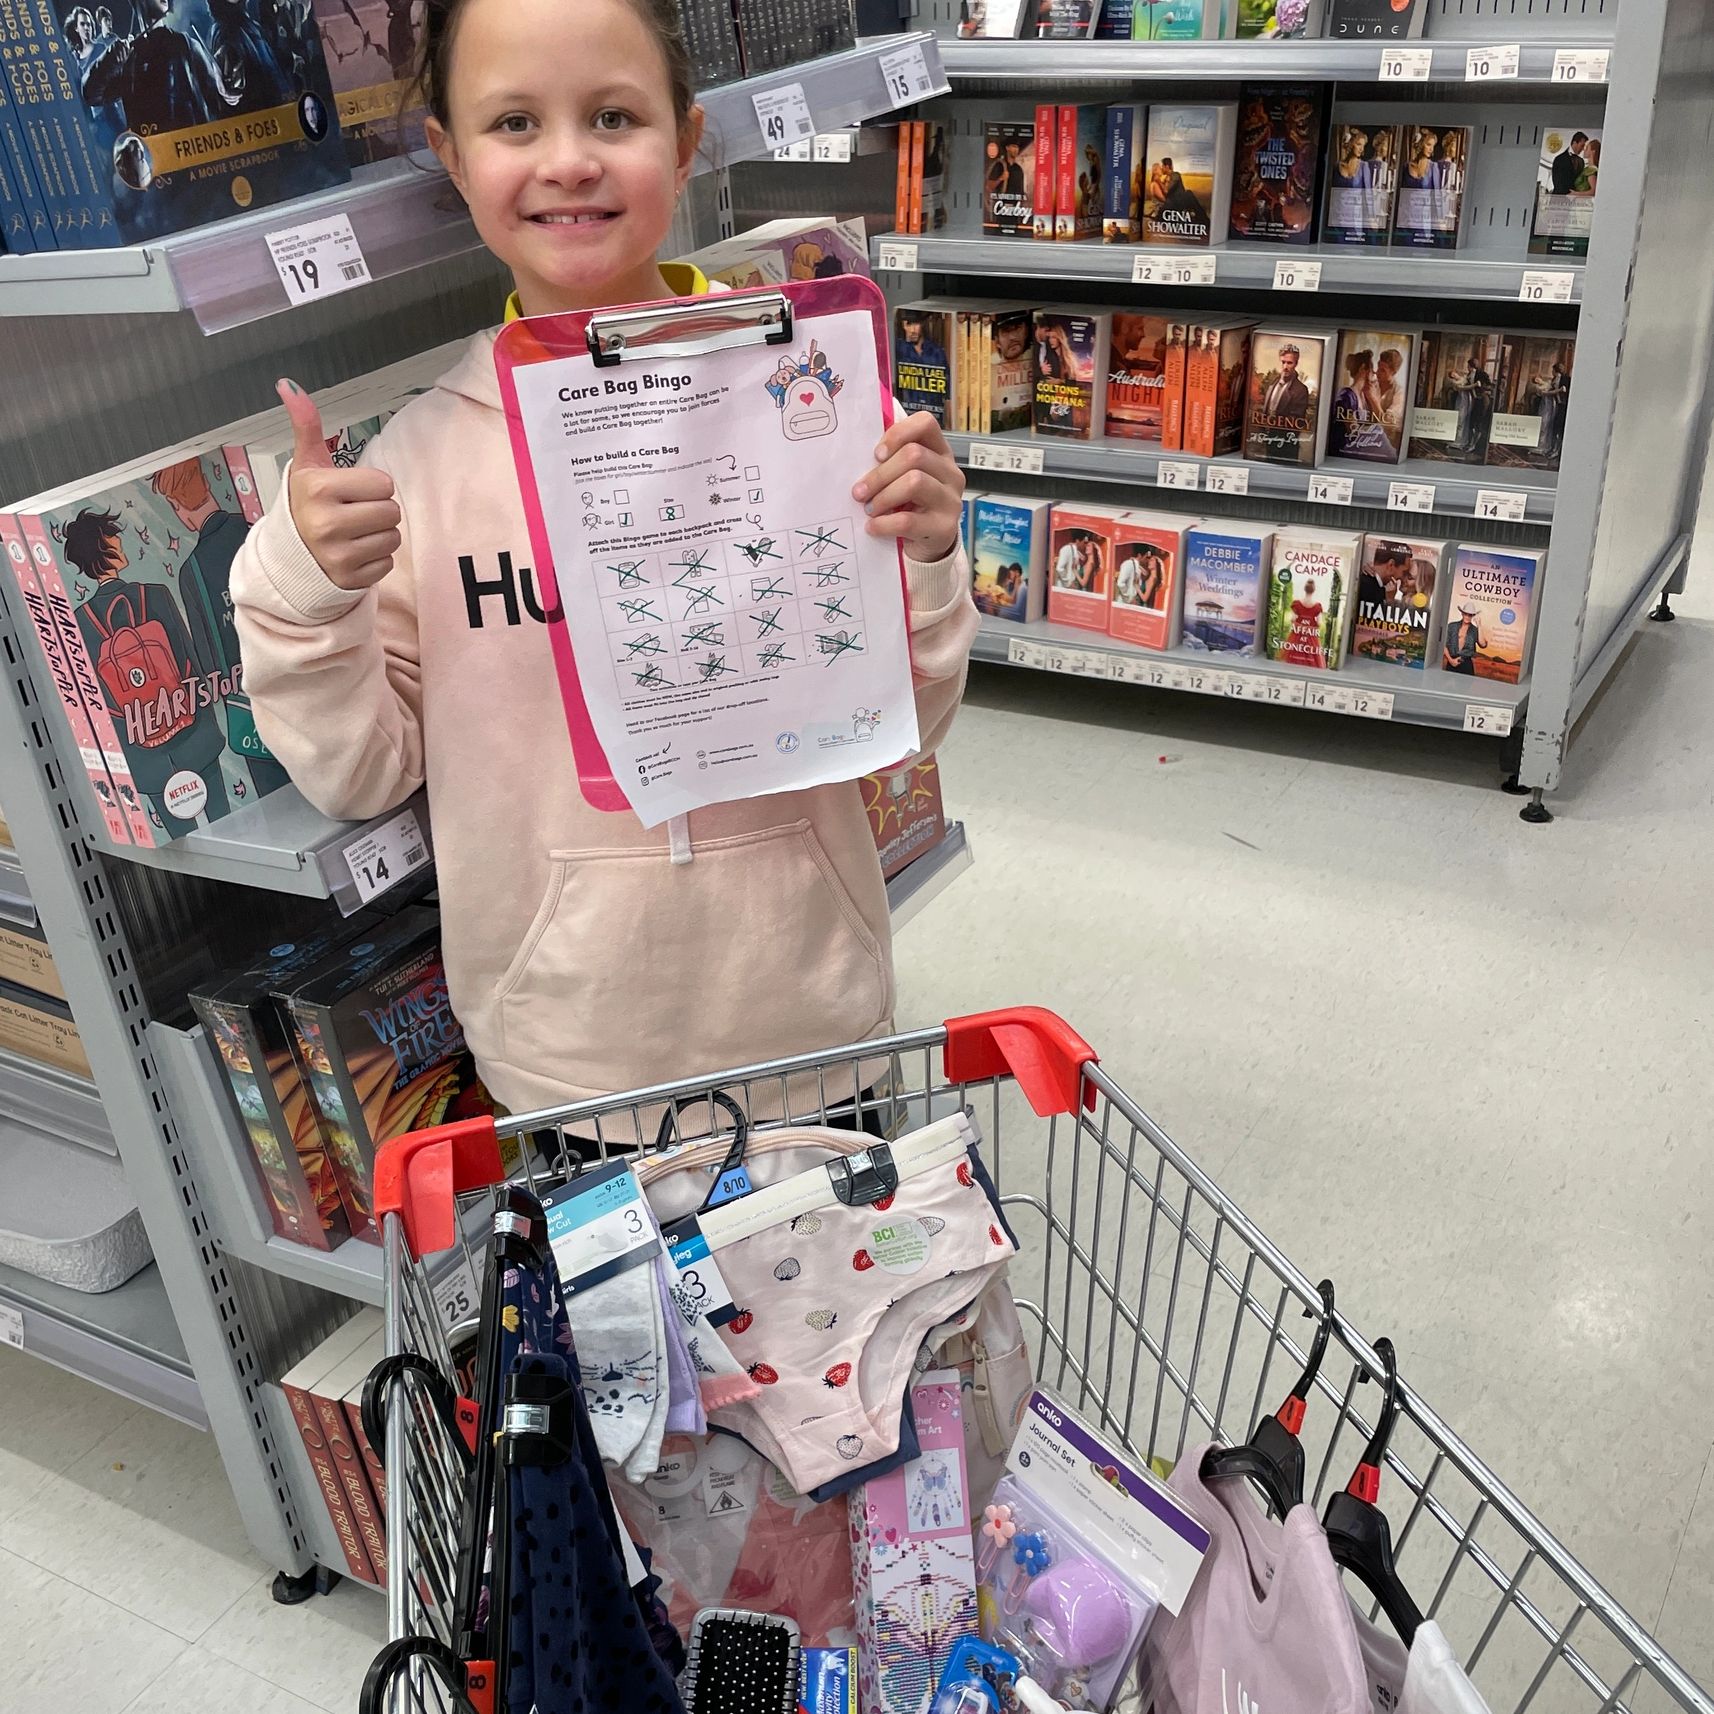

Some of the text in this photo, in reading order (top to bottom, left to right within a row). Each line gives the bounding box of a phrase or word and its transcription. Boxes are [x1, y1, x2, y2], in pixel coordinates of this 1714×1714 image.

[1385, 62, 1402, 77] 10
[1473, 61, 1490, 77] 10
[1559, 65, 1576, 80] 10
[20, 62, 39, 104] FOES
[34, 60, 54, 102] FOES
[53, 59, 73, 100] FOES
[891, 76, 909, 99] 15
[767, 116, 784, 141] 49
[174, 117, 281, 159] FRIENDS & FOES
[1267, 138, 1285, 152] THE
[189, 150, 281, 181] A MOVIE SCRAPBOOK
[1255, 151, 1295, 166] TWISTED
[1260, 166, 1288, 180] ONES
[993, 201, 1034, 225] Cowboy
[1162, 209, 1192, 223] GENA
[1148, 221, 1207, 236] SHOWALTER
[884, 256, 897, 268] 10
[288, 259, 319, 293] 19
[1138, 267, 1152, 280] 12
[1177, 270, 1191, 282] 10
[1279, 274, 1295, 287] 10
[1526, 285, 1543, 300] 10
[898, 364, 946, 380] LINDA LAEL
[558, 373, 692, 402] Care Bag Bingo
[898, 375, 946, 394] MILLER
[1037, 383, 1080, 396] COLTONS
[562, 411, 573, 419] We
[575, 409, 592, 417] know
[594, 404, 618, 415] putting
[620, 400, 648, 410] together
[679, 395, 694, 403] Care
[696, 392, 708, 400] Bag
[632, 407, 665, 416] encourage
[667, 407, 678, 415] you
[688, 403, 700, 412] join
[701, 397, 720, 407] forces
[1251, 411, 1312, 430] REGENCY
[1335, 406, 1397, 424] REGENCY
[565, 428, 578, 437] and
[579, 425, 596, 434] build
[602, 422, 618, 430] Care
[619, 420, 632, 428] Bag
[633, 416, 663, 427] together!
[571, 456, 592, 466] How
[594, 453, 605, 462] to
[606, 449, 629, 460] build
[639, 446, 660, 456] Care
[662, 445, 680, 455] Bag
[974, 456, 986, 466] 12
[1010, 457, 1022, 468] 12
[1162, 472, 1176, 485] 12
[1211, 479, 1224, 491] 12
[1313, 486, 1328, 500] 14
[1394, 493, 1408, 507] 14
[666, 507, 675, 520] 8
[1483, 503, 1498, 517] 14
[1204, 546, 1241, 560] DEBBIE
[1285, 550, 1341, 567] CANDACE
[1190, 557, 1255, 574] MACOMBER
[1294, 564, 1328, 577] CAMP
[1206, 573, 1238, 587] Winter
[1462, 568, 1527, 587] ULTIMATE
[1199, 582, 1244, 599] Weddings
[1465, 581, 1521, 599] COWBOY
[1469, 594, 1512, 606] COLLECTION
[1359, 600, 1428, 629] ITALIAN
[1290, 622, 1321, 637] AFFAIR
[1358, 614, 1411, 635] PLAYBOYS
[24, 590, 79, 709] HEARTSTOPPER
[48, 591, 103, 712] HEARTSTOPPER
[1013, 649, 1026, 661] 12
[1272, 637, 1334, 658] STONECLIFFE
[1050, 658, 1063, 670] 12
[1112, 665, 1125, 678] 12
[1150, 672, 1163, 684] 12
[1190, 677, 1203, 689] 12
[1230, 684, 1243, 696] 12
[1267, 688, 1281, 700] 12
[124, 663, 243, 745] HEARTSTOP
[1311, 693, 1325, 706] 14
[1354, 699, 1368, 712] 12
[1470, 716, 1485, 729] 12
[168, 780, 199, 801] NETFLIX
[362, 856, 389, 889] 14
[4, 935, 43, 958] Litter Tray
[375, 953, 434, 995] TUI SUTHERLAND
[14, 1007, 67, 1036] Cat Litter Tray
[409, 1020, 420, 1032] OF
[389, 1004, 460, 1075] FIRE
[605, 1177, 627, 1193] 9-12
[723, 1176, 746, 1194] 8/10
[556, 1217, 572, 1231] Cut
[623, 1209, 643, 1234] 3
[630, 1232, 649, 1244] PACK
[872, 1226, 897, 1246] BCI
[682, 1269, 706, 1300] 3
[445, 1291, 470, 1323] 25
[460, 1409, 474, 1424] 8
[1036, 1401, 1063, 1428] anko
[928, 1425, 943, 1436] Art
[1029, 1421, 1077, 1469] Journal Set
[317, 1465, 361, 1560] BLOOD TRAITOR
[658, 1506, 665, 1515] 8
[346, 1475, 387, 1570] BLOOD TRAITOR
[469, 1673, 487, 1691] 8
